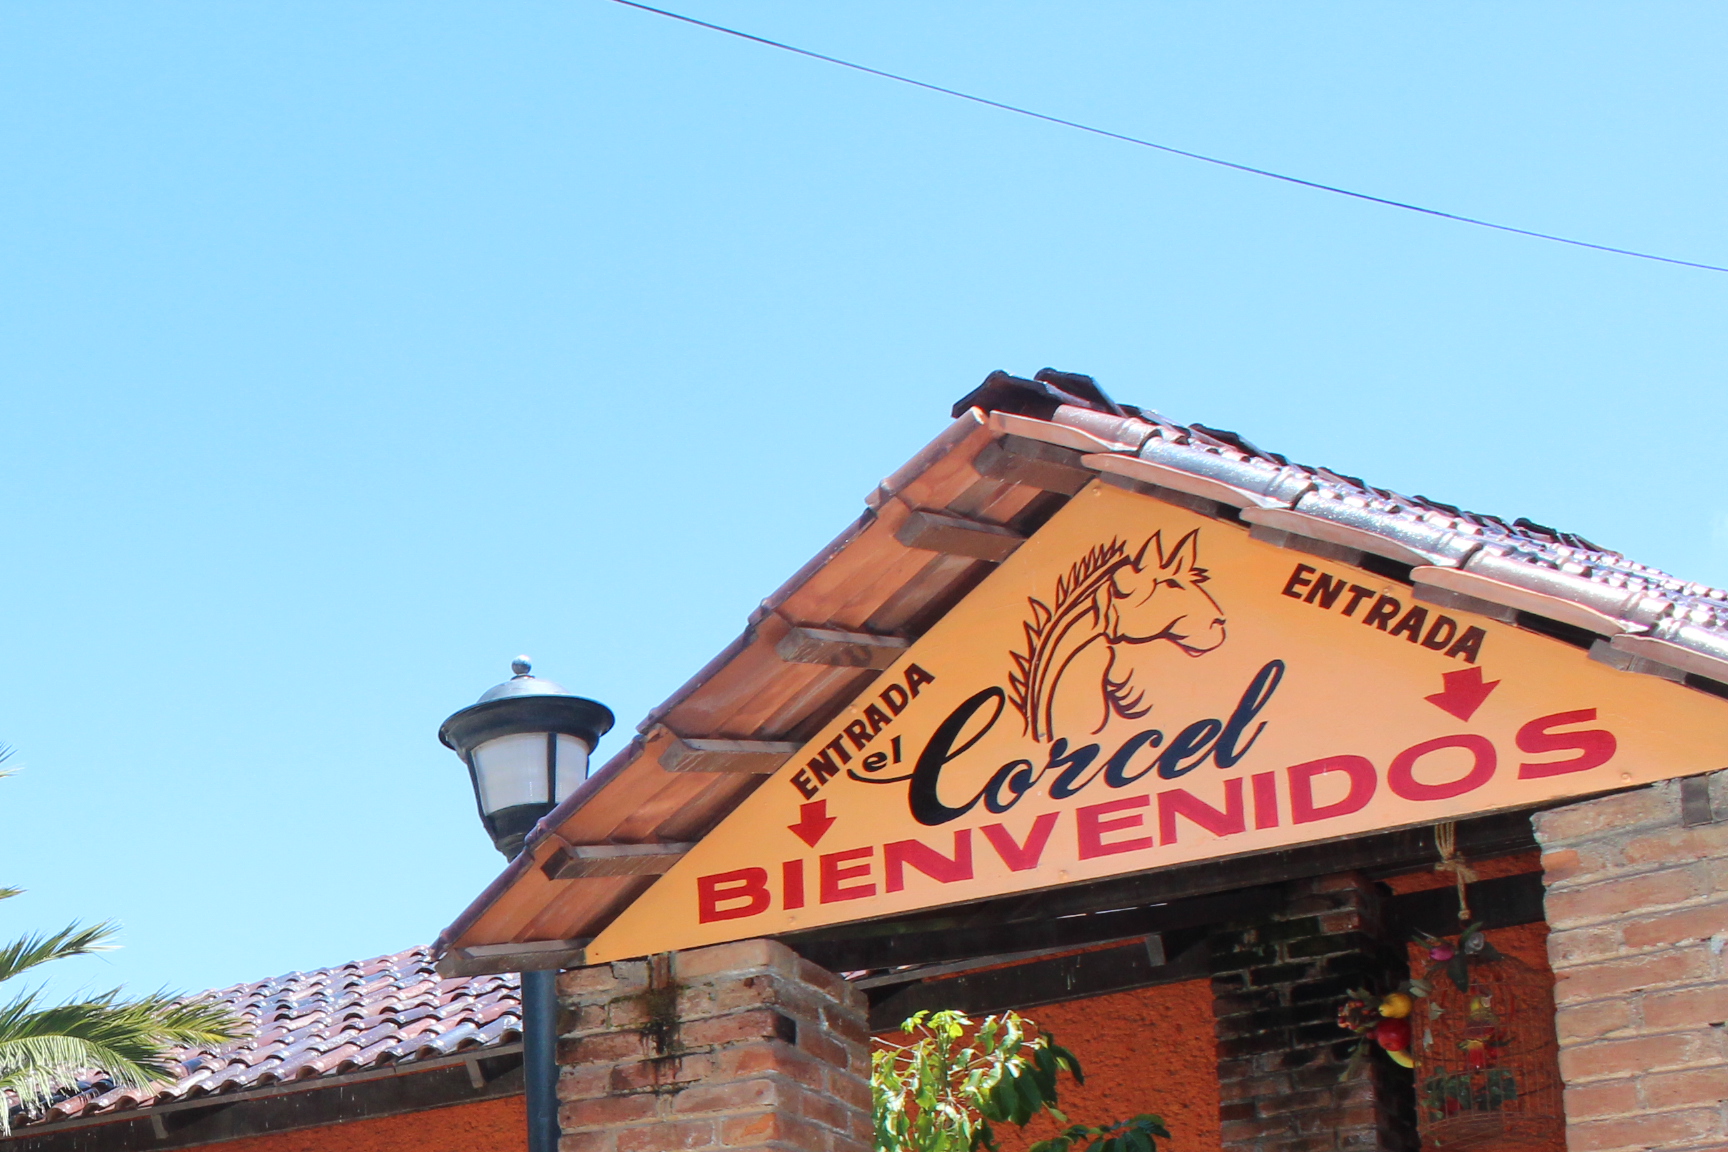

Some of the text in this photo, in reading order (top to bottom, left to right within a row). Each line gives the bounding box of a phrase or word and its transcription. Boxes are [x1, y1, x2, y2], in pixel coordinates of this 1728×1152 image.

[1280, 562, 1488, 664] ENTRADA
[789, 662, 936, 801] ENTRADA
[846, 659, 1285, 827] el Corcel
[696, 707, 1618, 925] BIENVENIDOS
